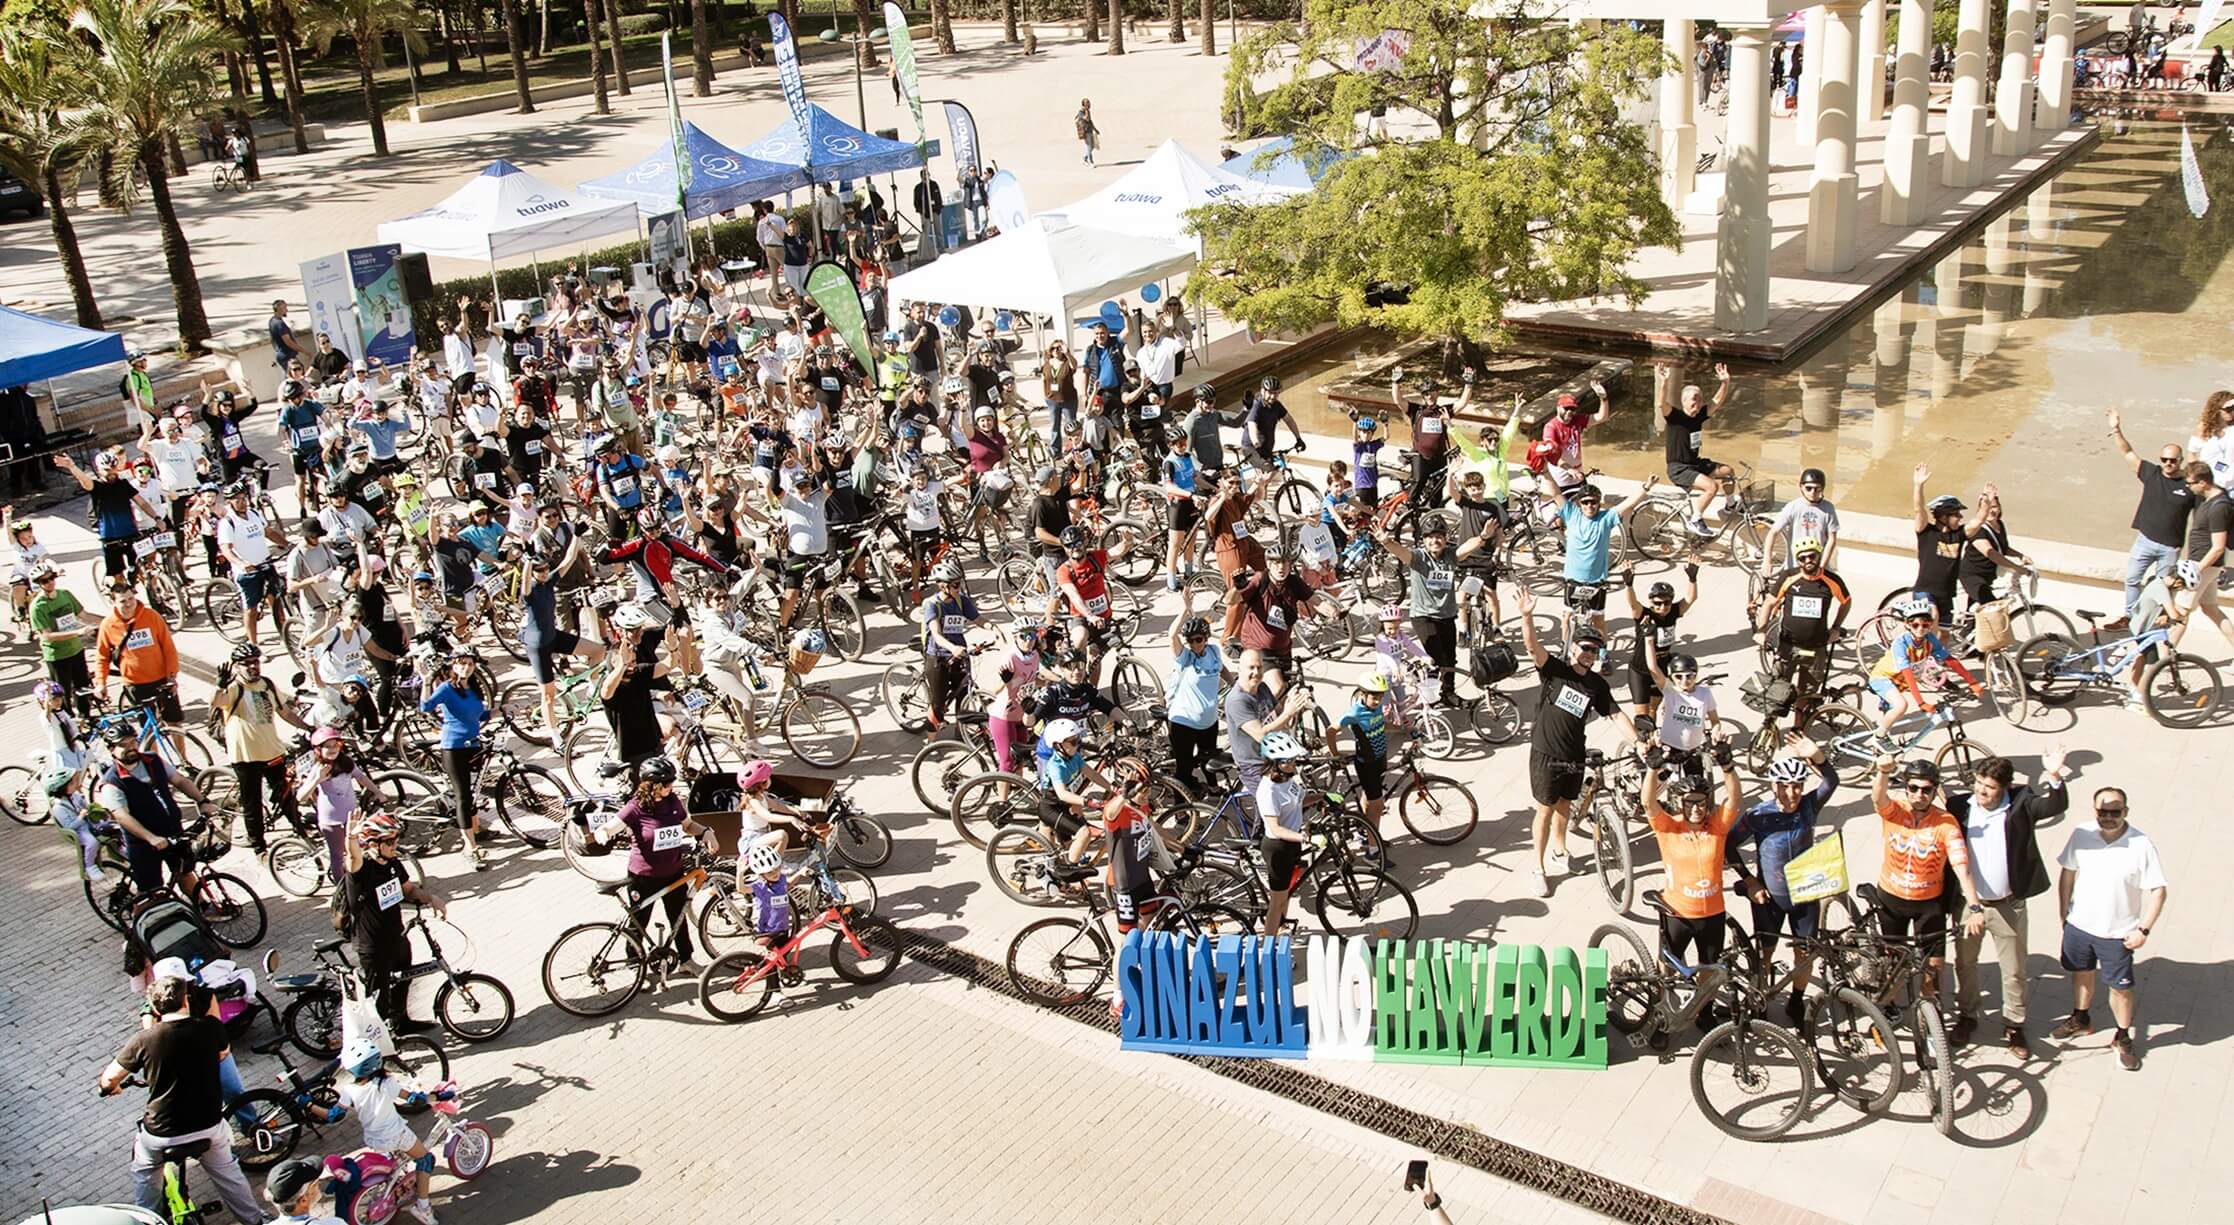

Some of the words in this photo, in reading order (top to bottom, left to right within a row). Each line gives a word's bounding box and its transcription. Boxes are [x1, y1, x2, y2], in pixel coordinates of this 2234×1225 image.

[1114, 192, 1162, 204] tuawa
[517, 199, 570, 217] tuawa
[1432, 572, 1449, 581] 104
[1798, 599, 1817, 609] 001
[129, 630, 147, 641] 098
[1565, 691, 1584, 706] 001
[1679, 705, 1698, 717] 001
[659, 829, 679, 840] 096
[381, 881, 397, 897] 097
